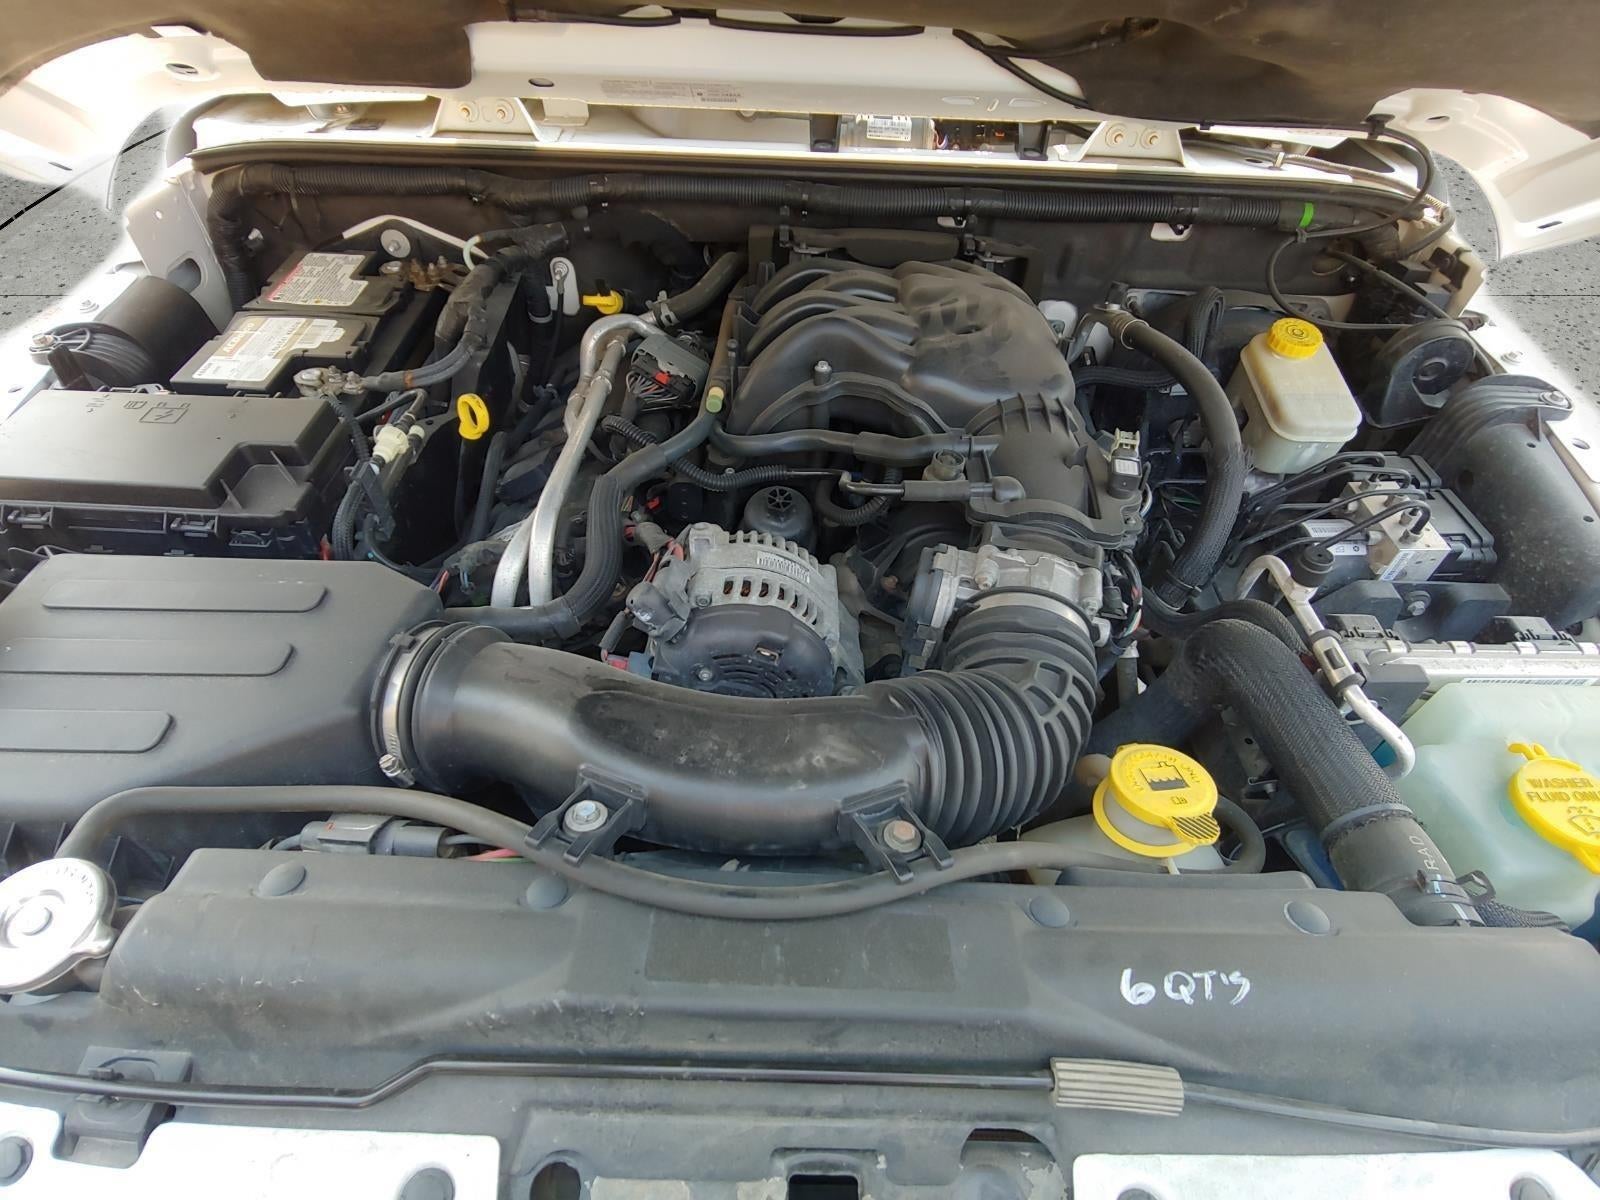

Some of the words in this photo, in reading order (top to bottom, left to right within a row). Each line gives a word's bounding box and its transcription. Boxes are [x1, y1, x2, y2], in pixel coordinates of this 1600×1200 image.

[1525, 777, 1594, 789] WASHER
[1525, 791, 1571, 802] FLUID
[1572, 790, 1600, 802] ONL
[1408, 835, 1440, 871] RAD
[1120, 967, 1156, 1006] 6
